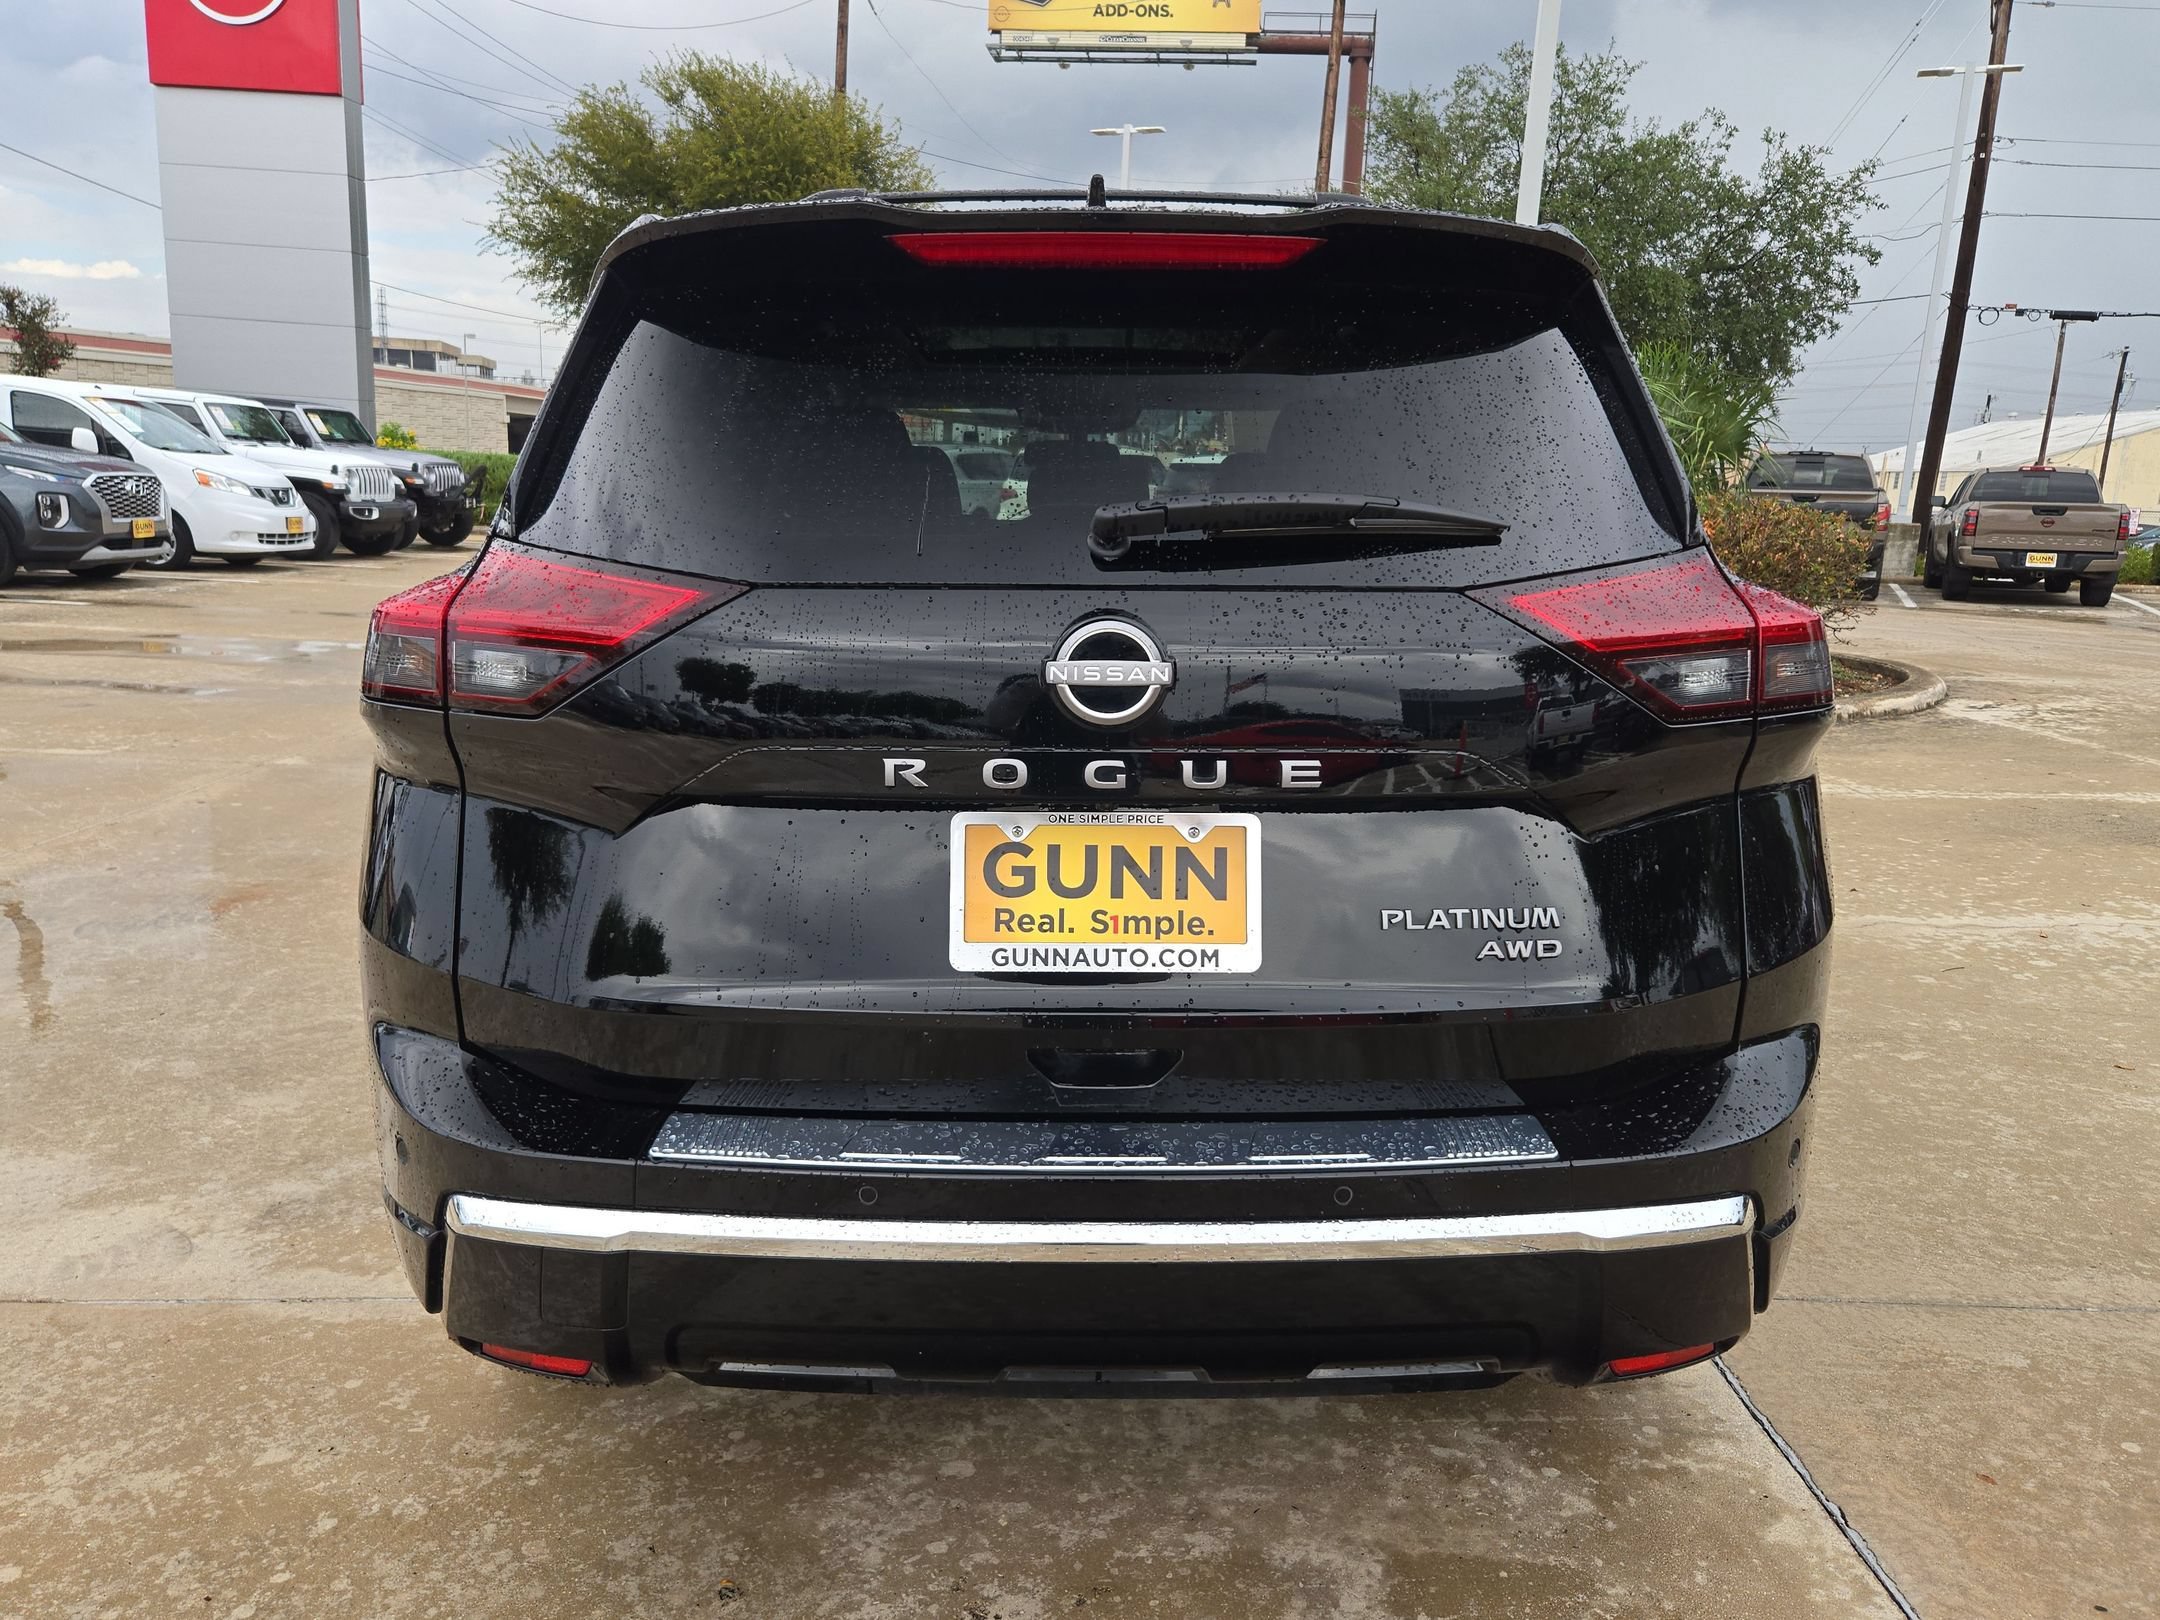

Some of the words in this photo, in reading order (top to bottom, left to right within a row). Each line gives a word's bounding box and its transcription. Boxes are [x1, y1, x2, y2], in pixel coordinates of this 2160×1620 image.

[1092, 3, 1174, 18] ADD-ONS.
[1049, 664, 1170, 683] NISSAN
[882, 757, 1323, 790] ROGUE
[1048, 814, 1075, 824] ONE
[1079, 814, 1124, 824] SIMPLE
[1127, 814, 1165, 824] PRICE
[983, 841, 1228, 902] GUNN
[994, 907, 1074, 934] Real.
[1381, 906, 1561, 930] PLATINUM
[991, 947, 1220, 968] GUNNAUTO.COM
[1475, 939, 1563, 960] AWD
